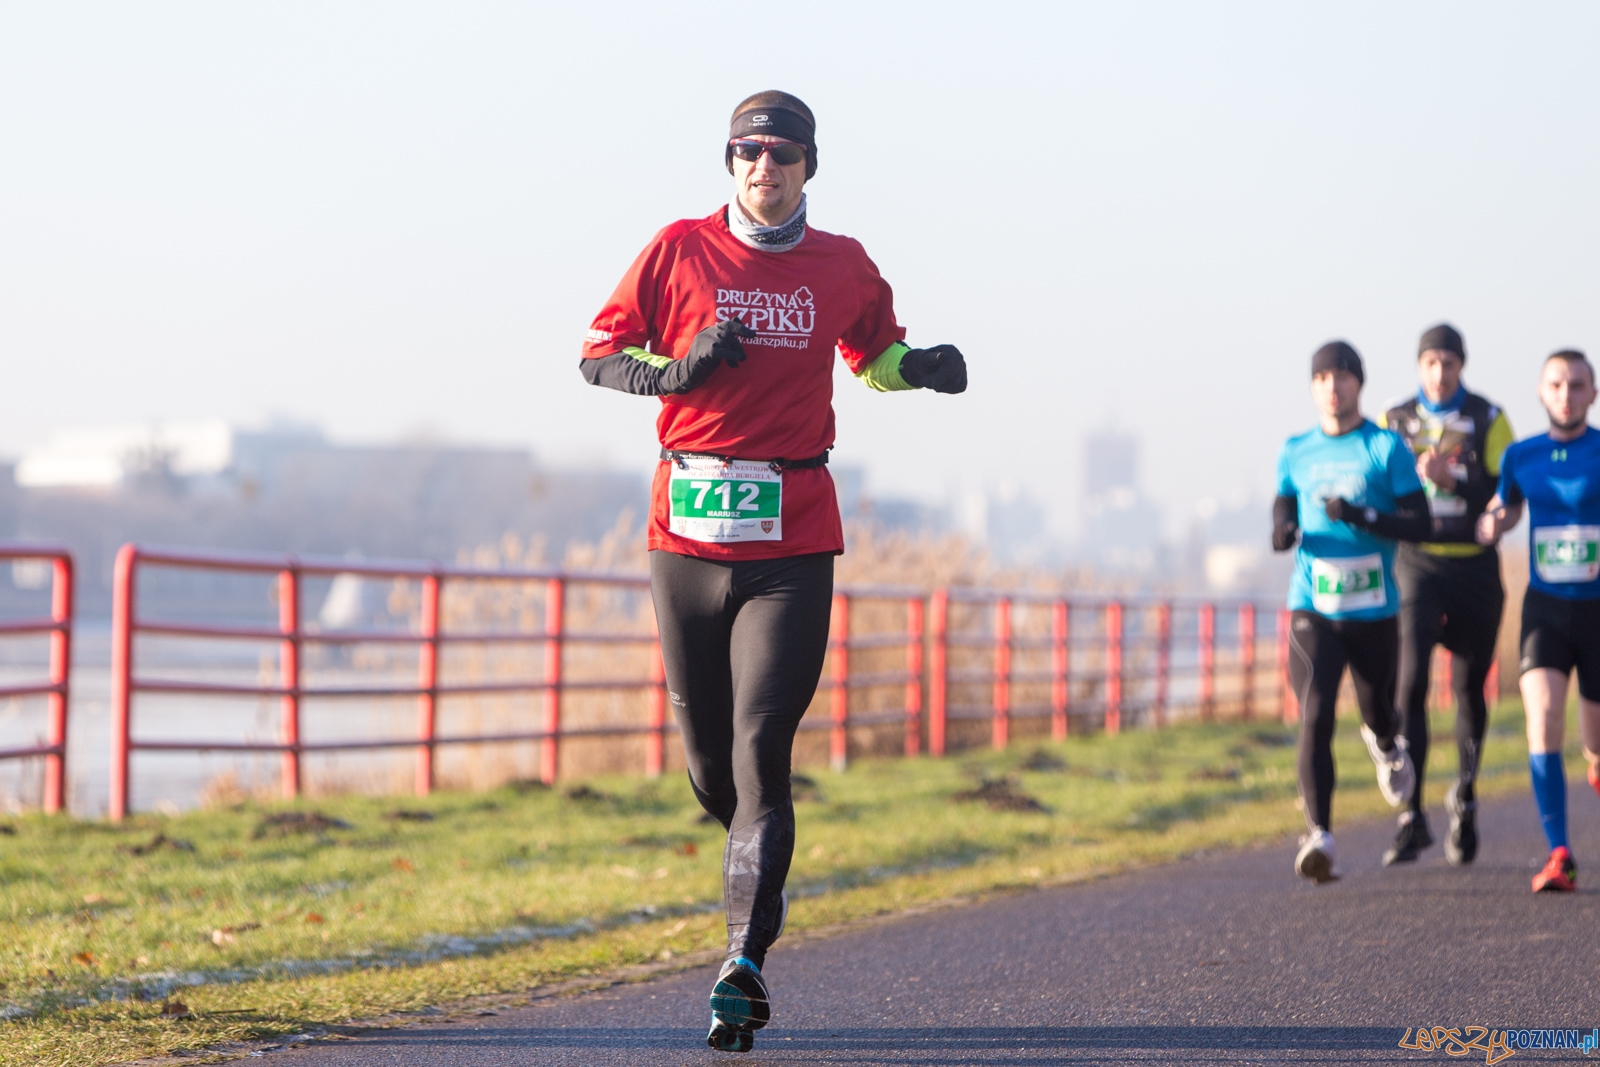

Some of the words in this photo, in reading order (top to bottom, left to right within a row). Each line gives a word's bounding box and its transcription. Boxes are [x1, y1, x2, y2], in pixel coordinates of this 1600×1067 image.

[716, 288, 798, 309] DRUŻYNA
[715, 307, 816, 333] SZPIKU
[735, 472, 771, 480] BURGIELA
[690, 481, 760, 511] 712
[706, 510, 741, 518] MARIUSZ
